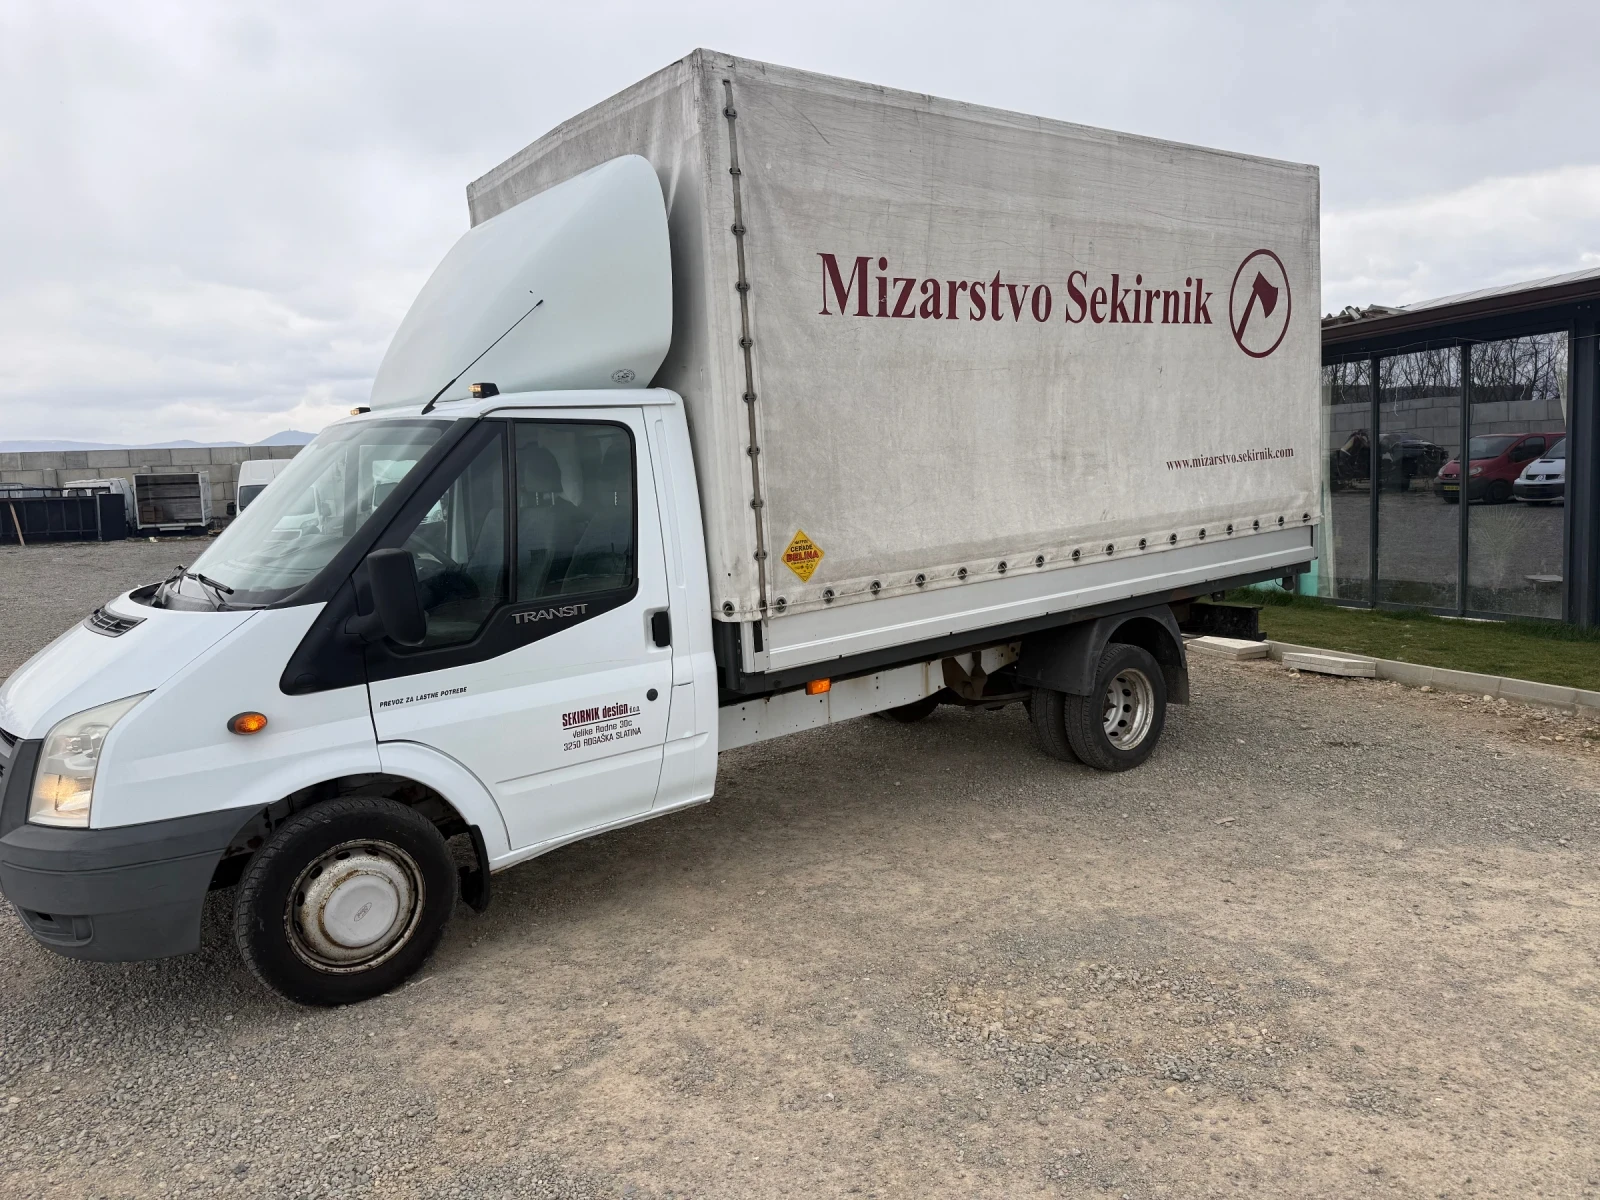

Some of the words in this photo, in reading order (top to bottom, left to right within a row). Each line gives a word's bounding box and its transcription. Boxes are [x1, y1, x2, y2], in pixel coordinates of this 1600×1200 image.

[816, 252, 1053, 323] Mizarstvo
[1065, 269, 1213, 325] Sekirnik
[1166, 447, 1294, 471] www.mizarstvo.sekirnik.com
[786, 550, 819, 562] BELINA
[511, 603, 588, 625] TRANSIT
[379, 698, 404, 708] PREVOZ
[405, 696, 414, 704] ZA
[415, 691, 439, 702] LASTNE
[440, 686, 468, 697] POTREBE
[562, 707, 601, 727] SEKIRNIK
[602, 702, 628, 719] design
[563, 740, 581, 752] 3250
[583, 732, 614, 747] ROGAŠKA
[616, 726, 642, 740] SLATINA
[572, 728, 594, 739] Velike
[595, 723, 618, 734] Rodne
